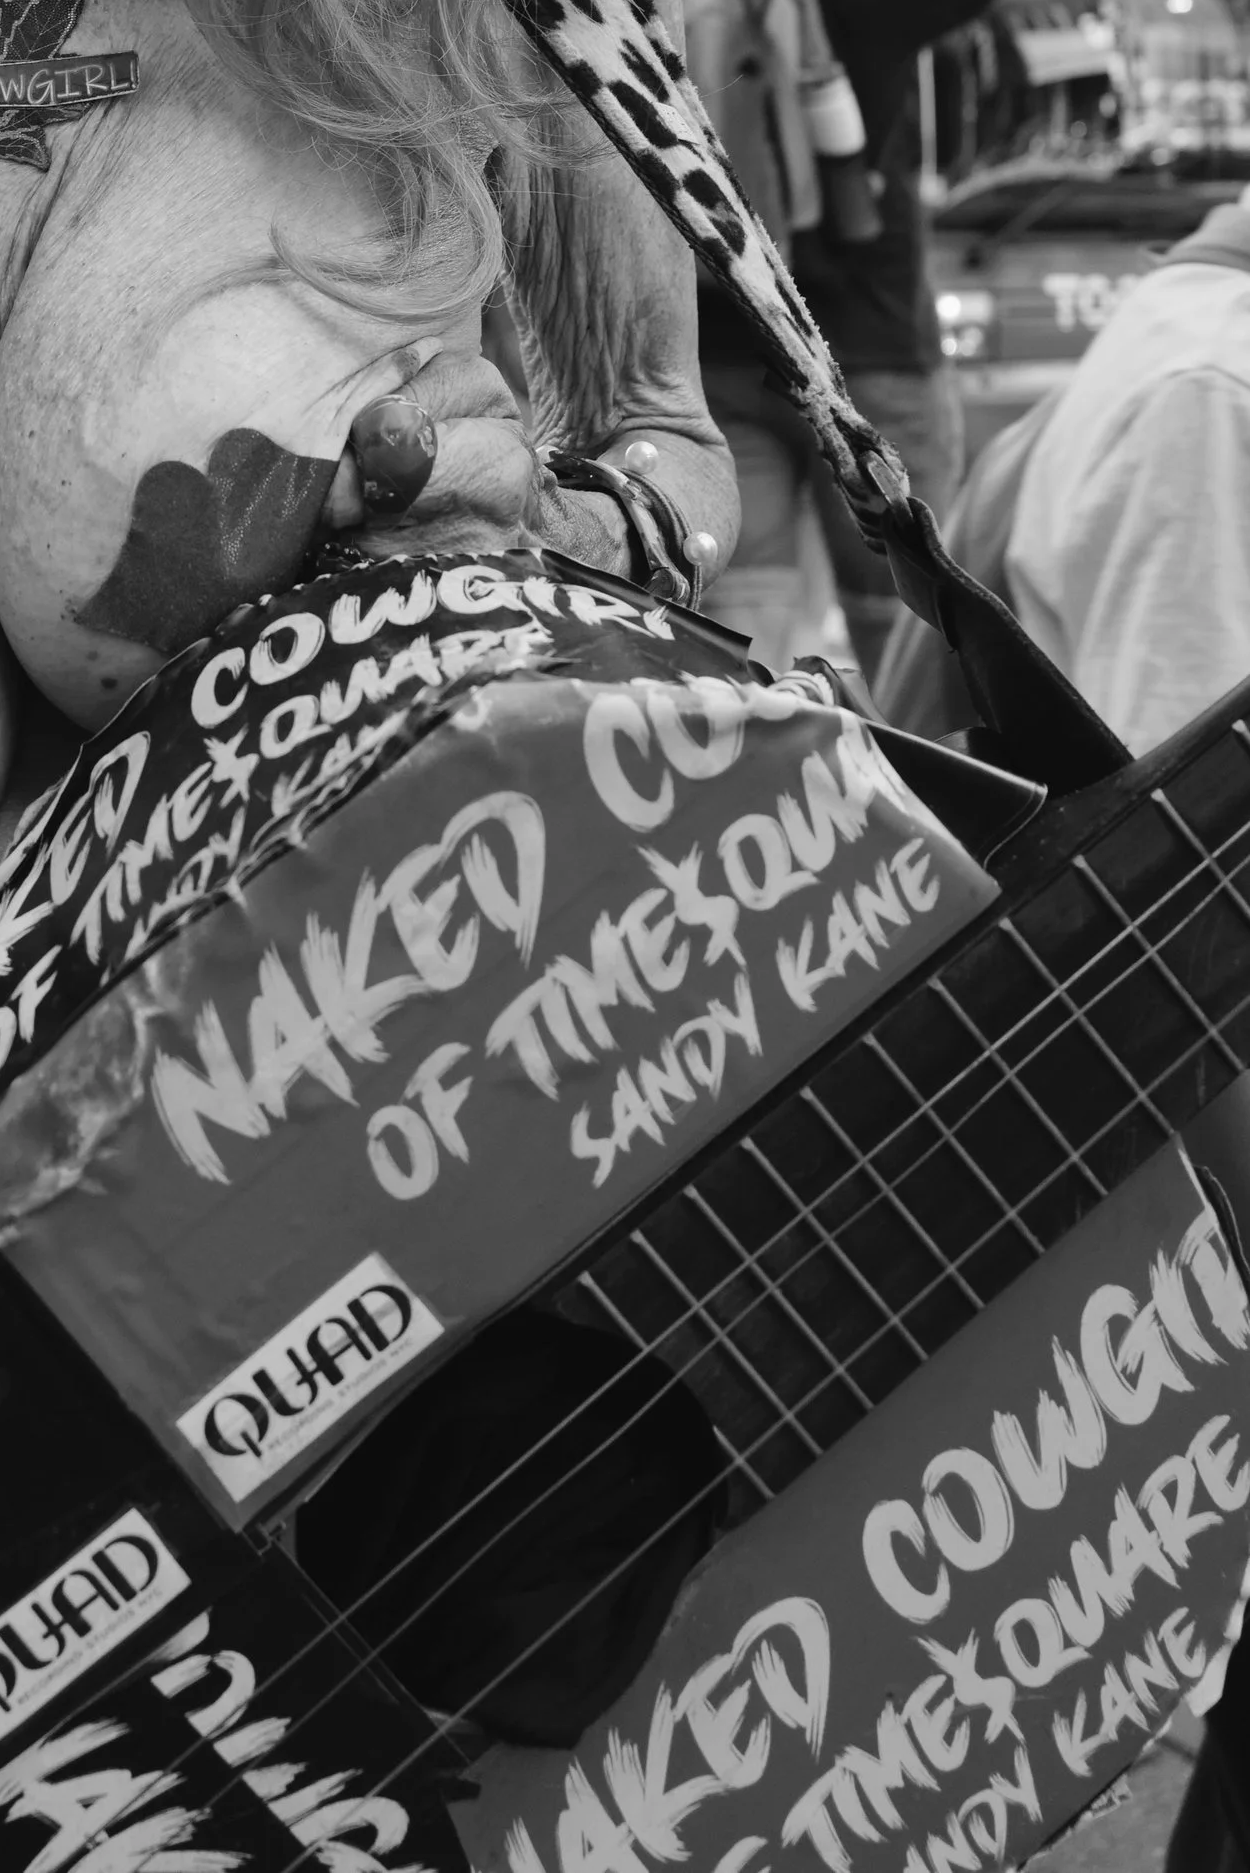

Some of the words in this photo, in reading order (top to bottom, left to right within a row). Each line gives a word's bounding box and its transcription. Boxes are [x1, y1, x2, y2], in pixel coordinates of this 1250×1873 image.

[152, 788, 547, 1186] NAKED
[572, 975, 763, 1188] SANDY
[776, 837, 941, 1013] KANE
[366, 1044, 475, 1200] OF
[203, 1284, 413, 1459] QUAD
[502, 1596, 831, 1873] AKED
[1052, 1604, 1206, 1778] KANE
